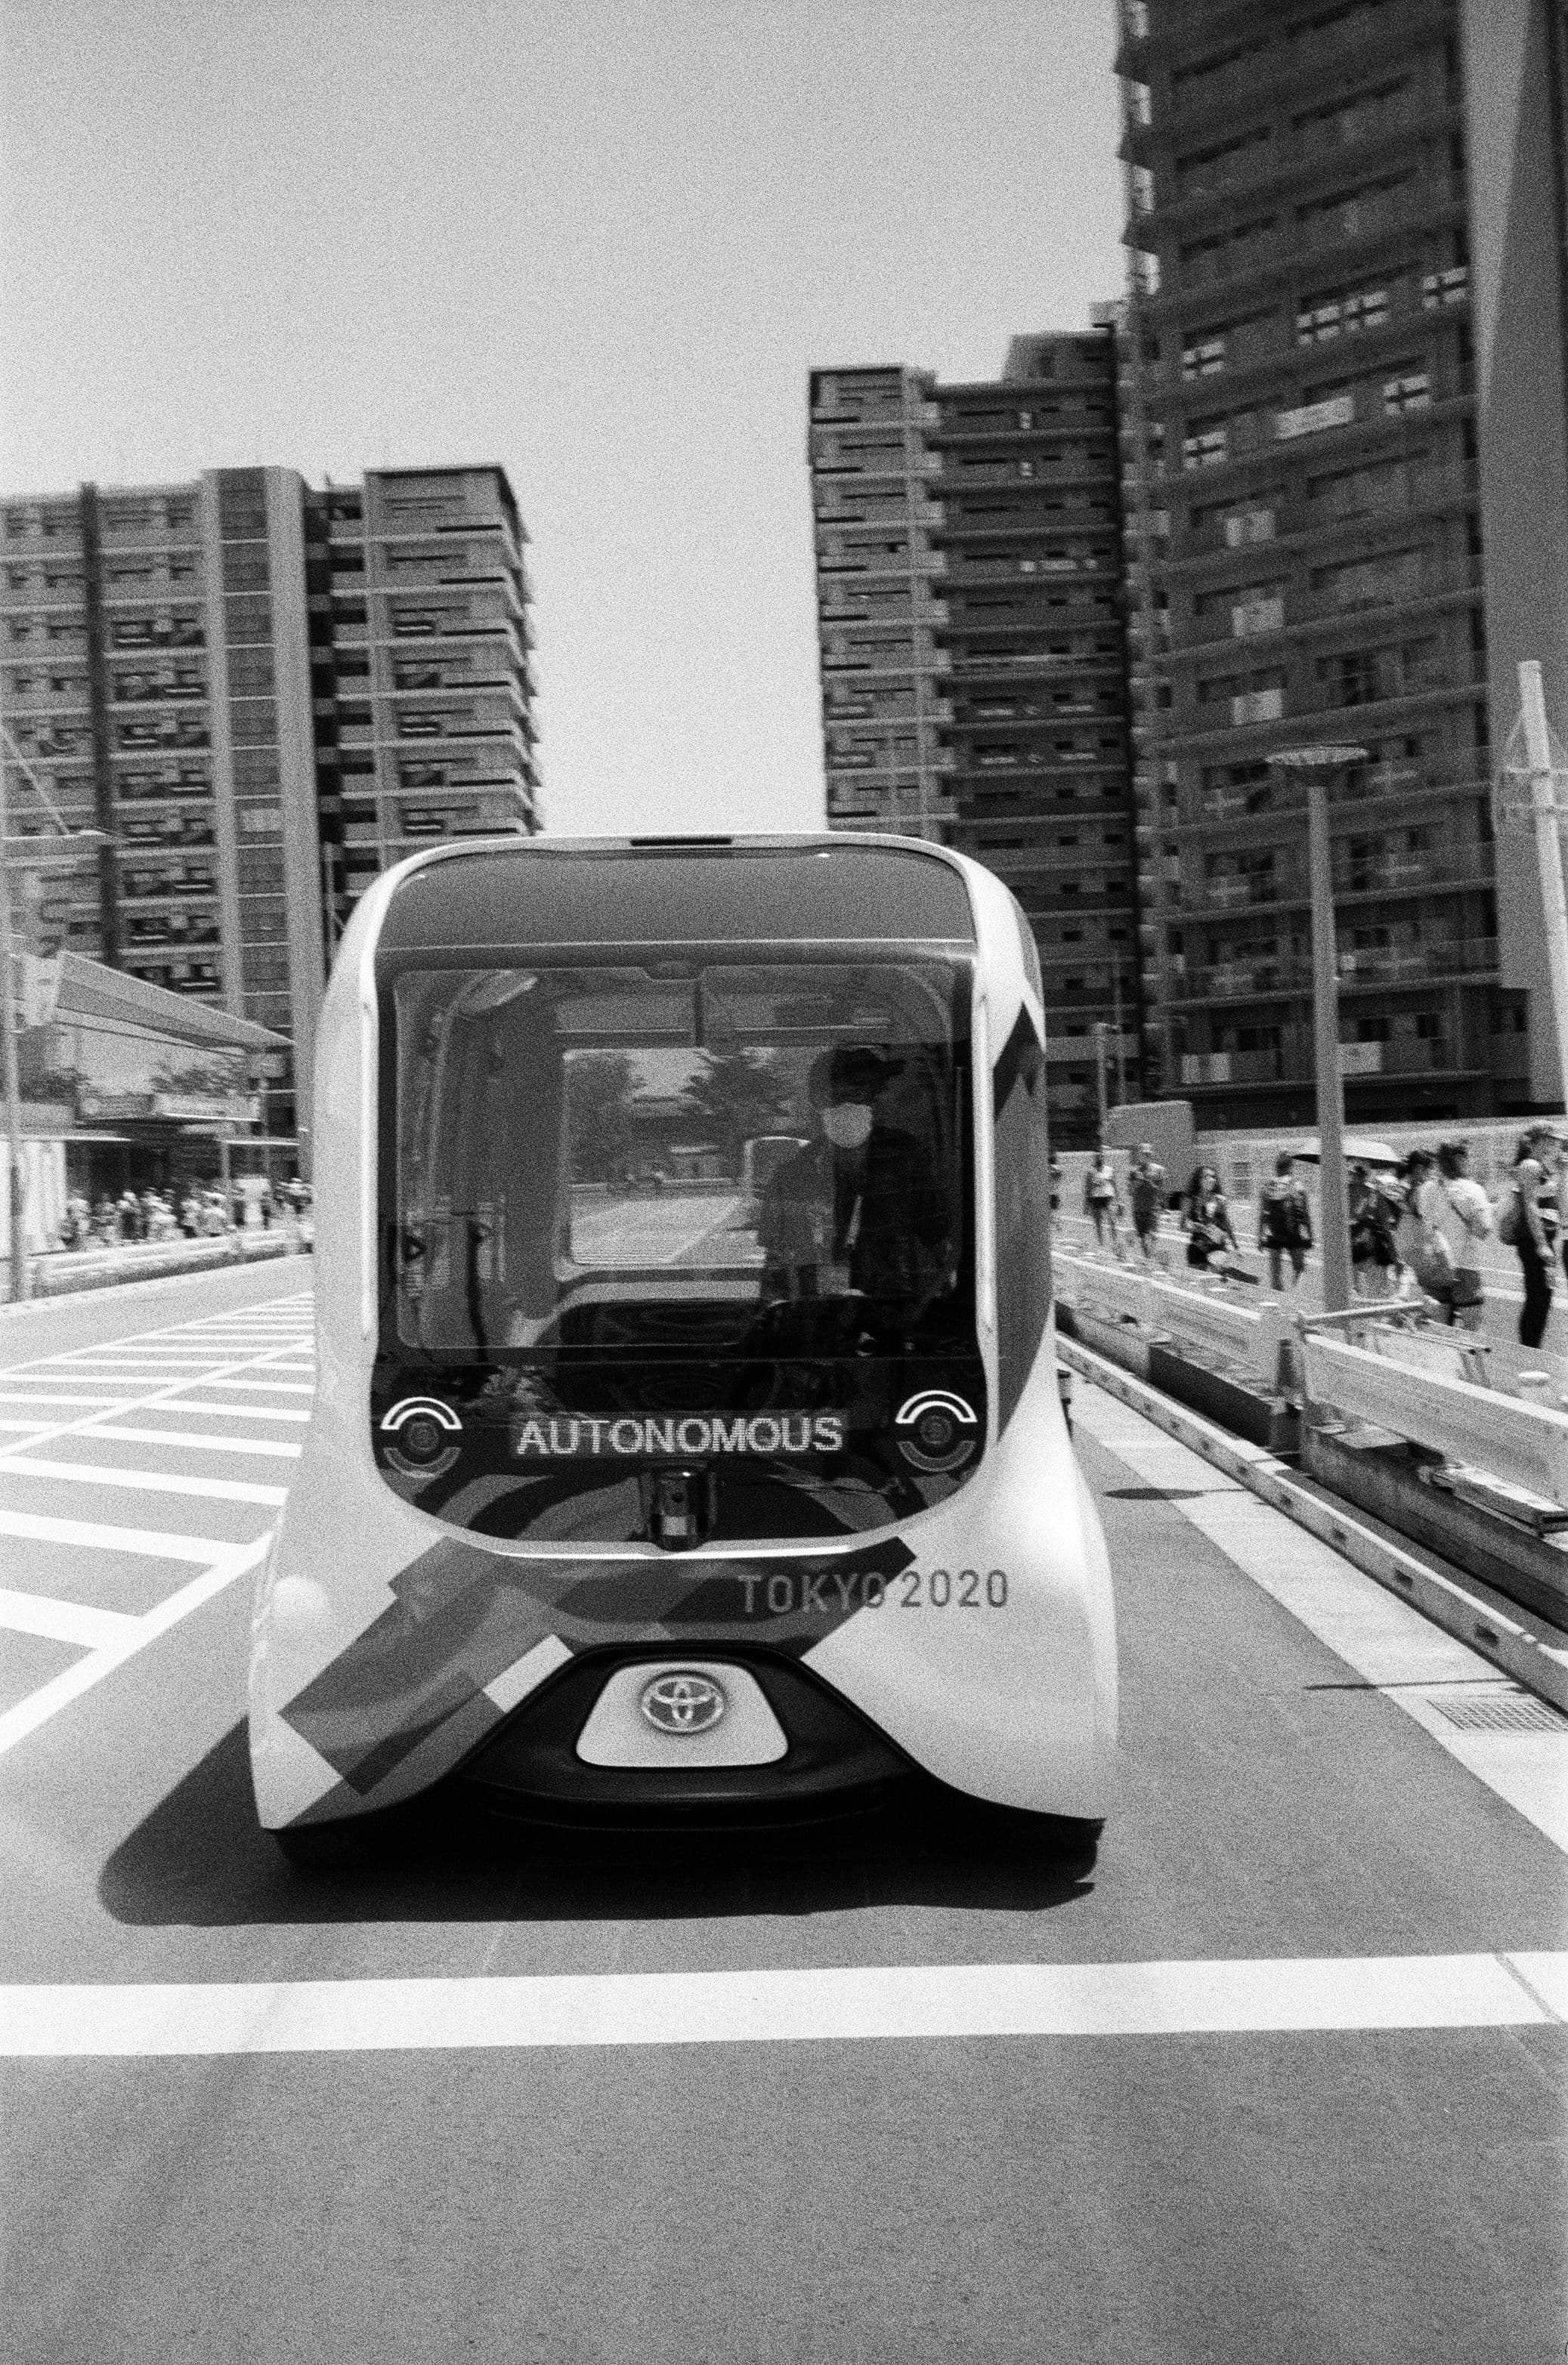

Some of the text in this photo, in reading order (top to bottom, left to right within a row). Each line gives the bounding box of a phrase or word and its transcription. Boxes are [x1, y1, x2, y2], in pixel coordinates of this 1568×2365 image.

[517, 1417, 843, 1454] AUTONOMOUS
[738, 1569, 1007, 1612] TOKYO 2020
